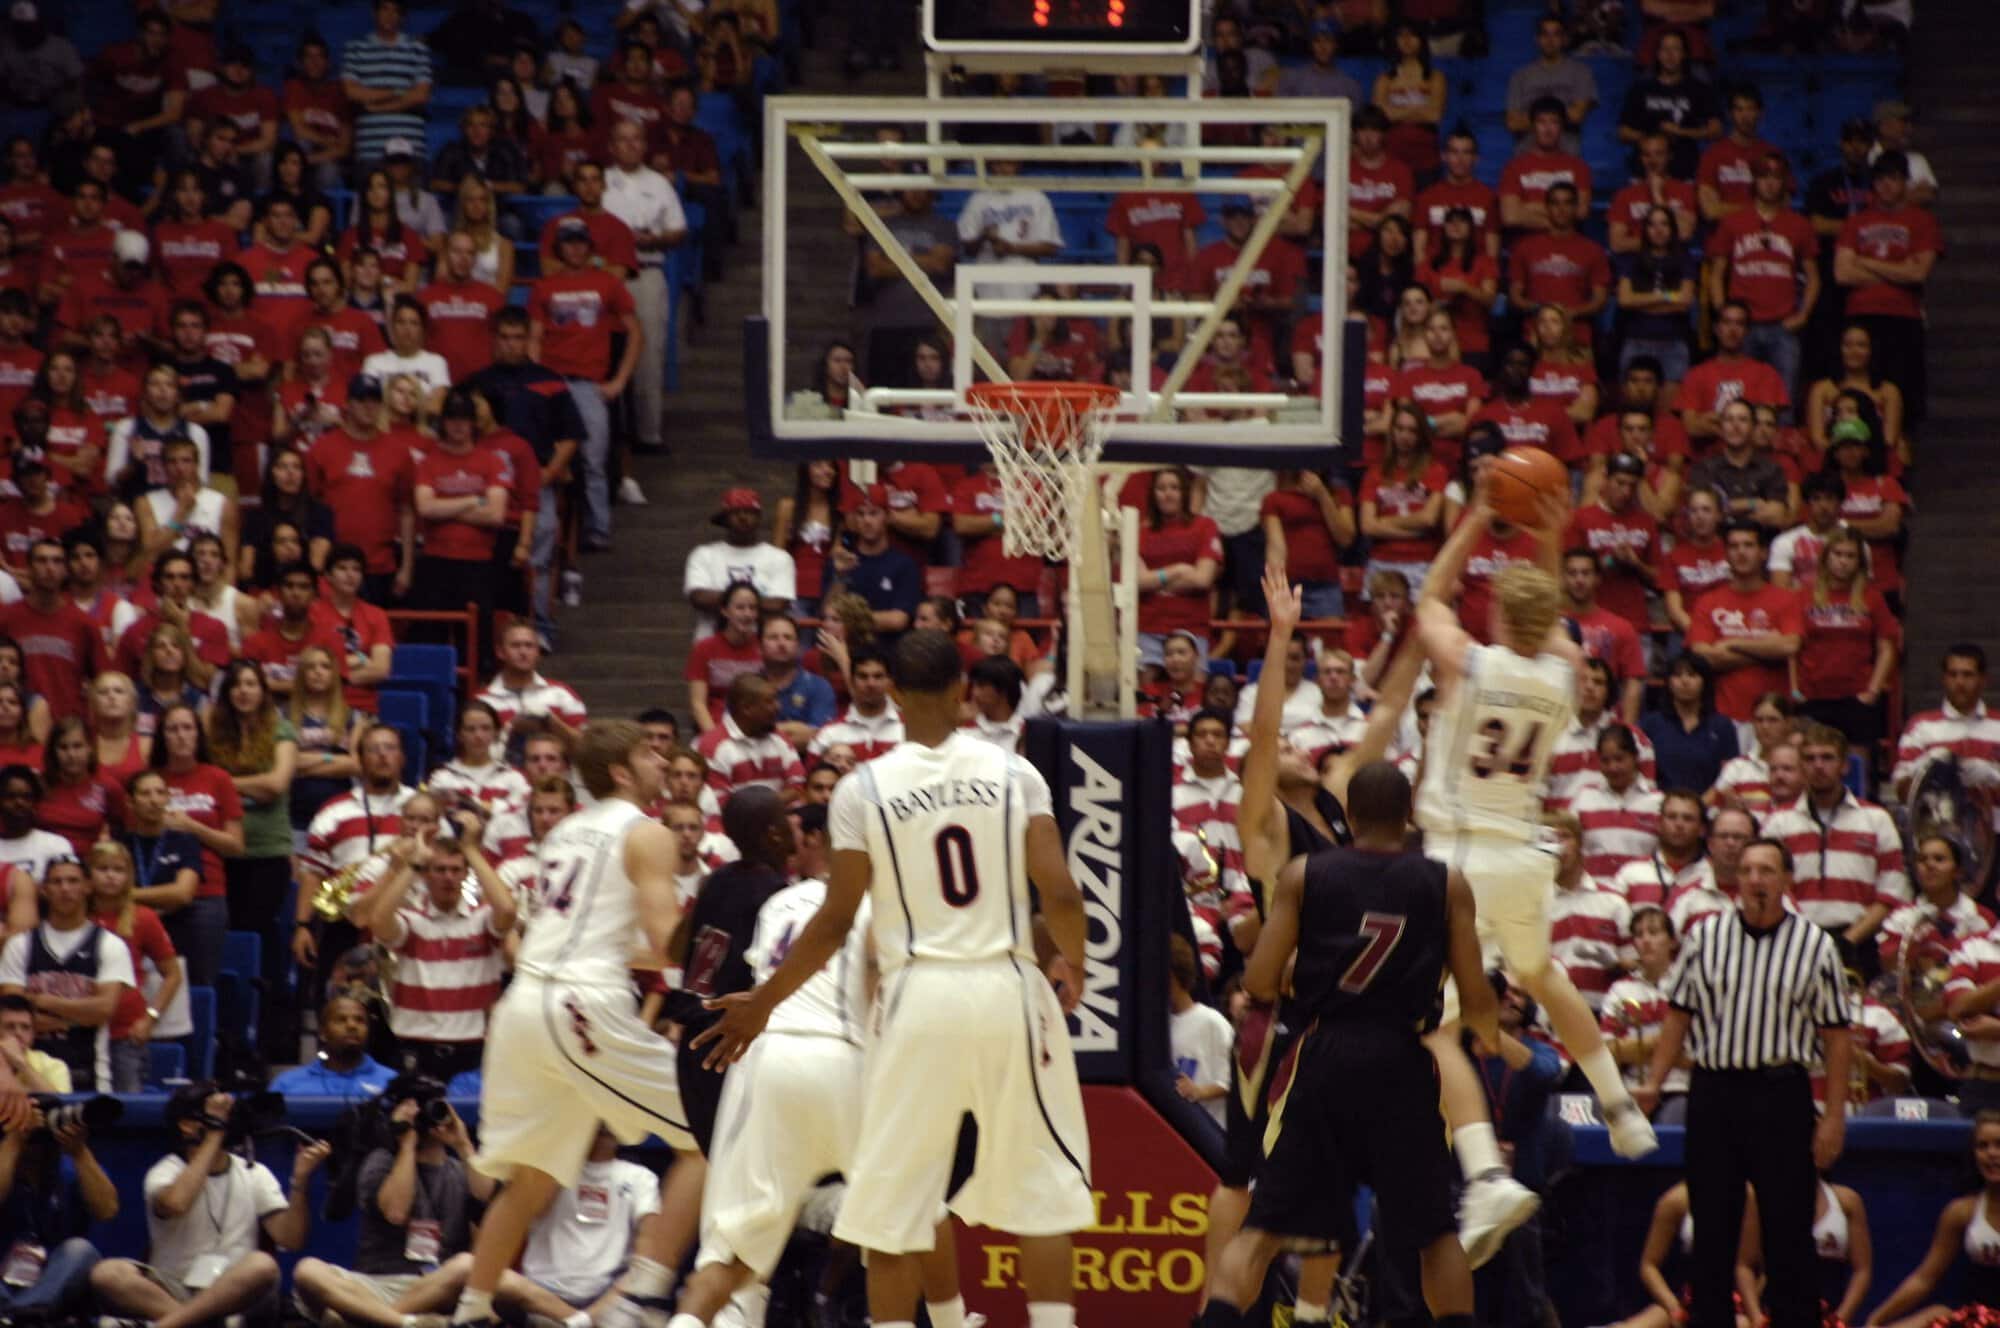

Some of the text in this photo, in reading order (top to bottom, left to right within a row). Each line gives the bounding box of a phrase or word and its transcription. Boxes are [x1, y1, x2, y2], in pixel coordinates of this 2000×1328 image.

[1470, 716, 1544, 783] 34
[888, 778, 1001, 822] BAYLESS
[935, 824, 980, 909] 0
[1068, 743, 1122, 1051] ARIZONA
[1338, 911, 1407, 994] 7
[1080, 1190, 1209, 1236] LLS
[981, 1245, 1206, 1294] FRGO
